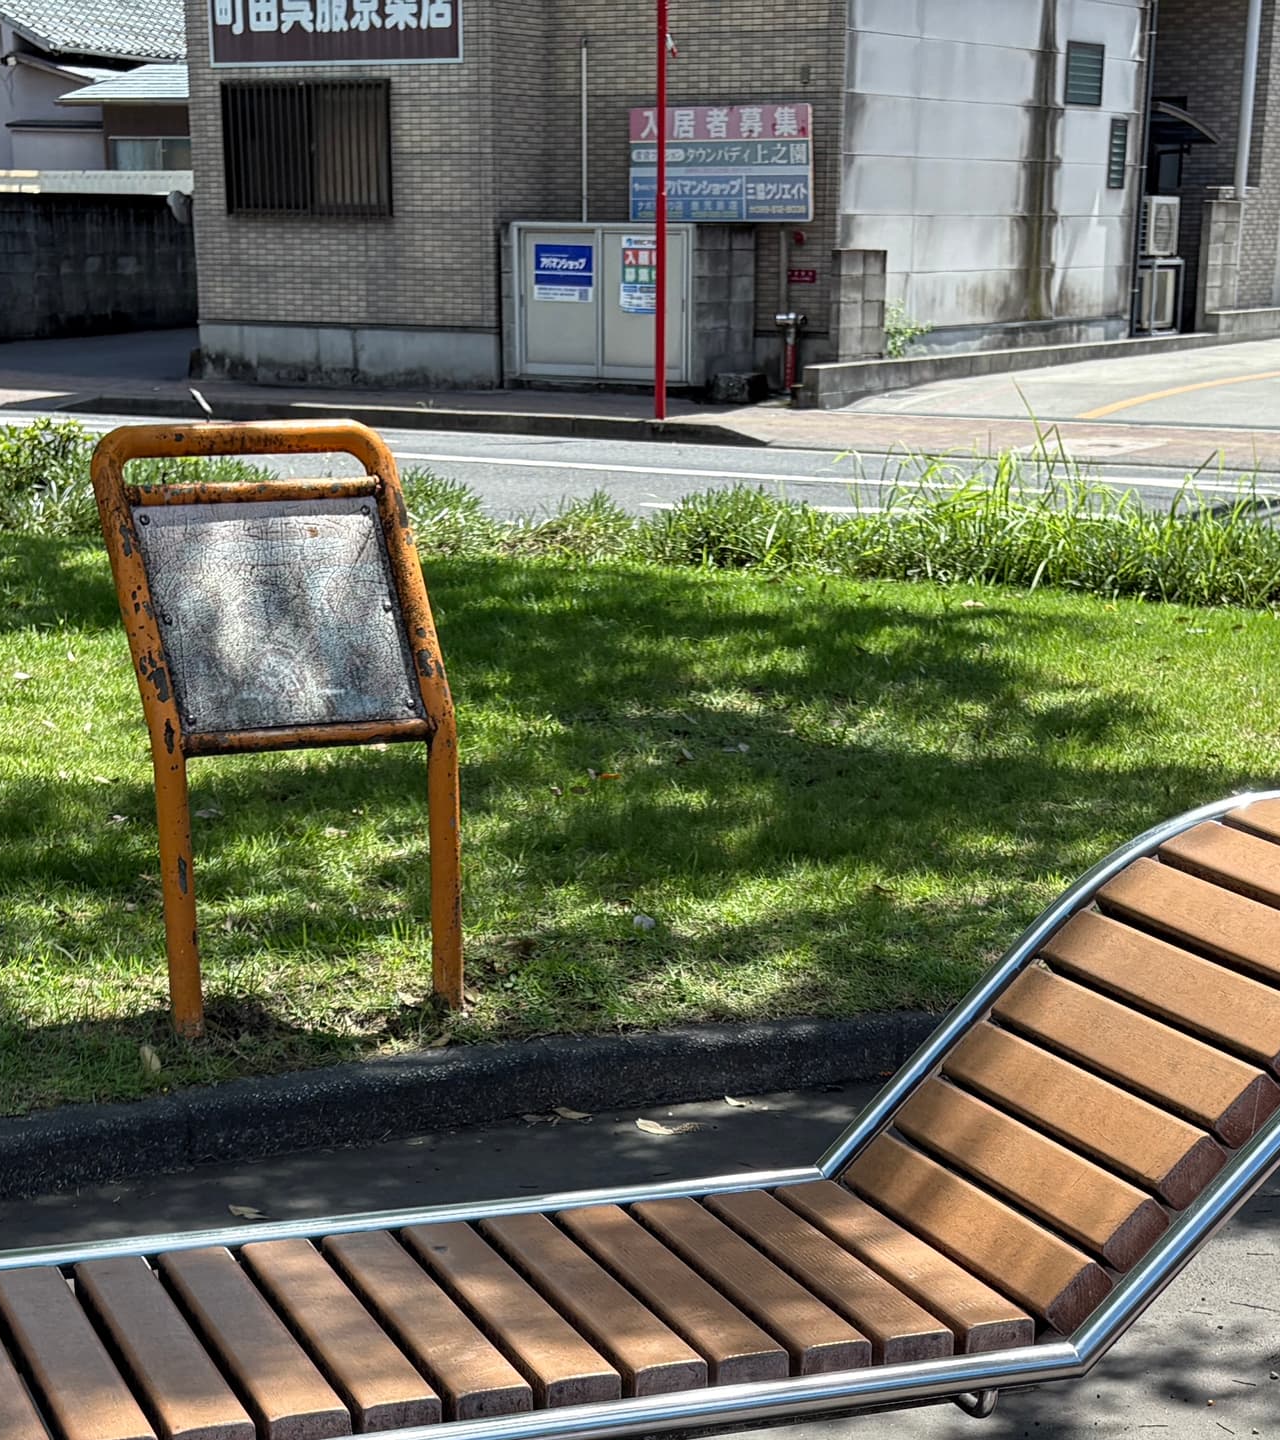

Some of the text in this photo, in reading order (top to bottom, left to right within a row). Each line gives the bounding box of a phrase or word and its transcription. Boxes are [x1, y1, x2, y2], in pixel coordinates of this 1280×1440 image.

[640, 106, 799, 139] 入居者募集
